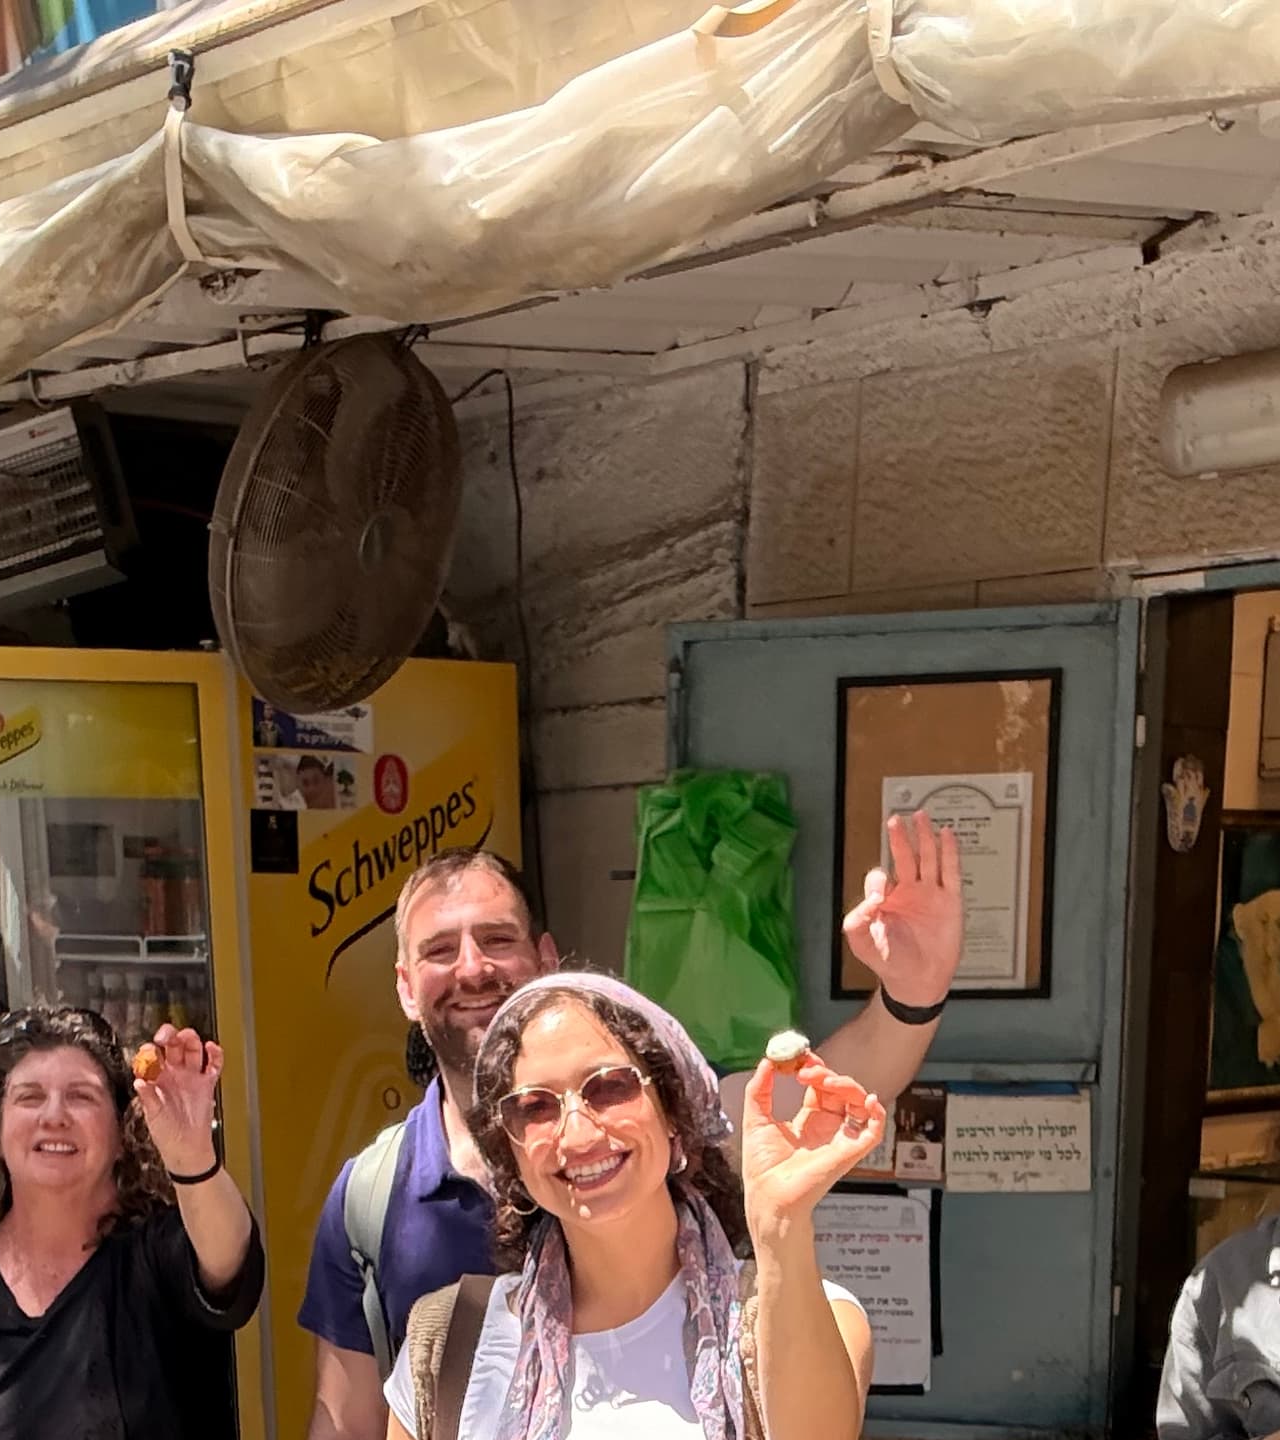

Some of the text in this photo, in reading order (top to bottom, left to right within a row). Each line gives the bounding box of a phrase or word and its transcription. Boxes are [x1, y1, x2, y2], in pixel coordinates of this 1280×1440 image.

[308, 781, 476, 938] Schweppes
[956, 1117, 1077, 1141] תפילין לזיכוי הרבים
[952, 1143, 1082, 1162] לכל מי שרוצה להניח
